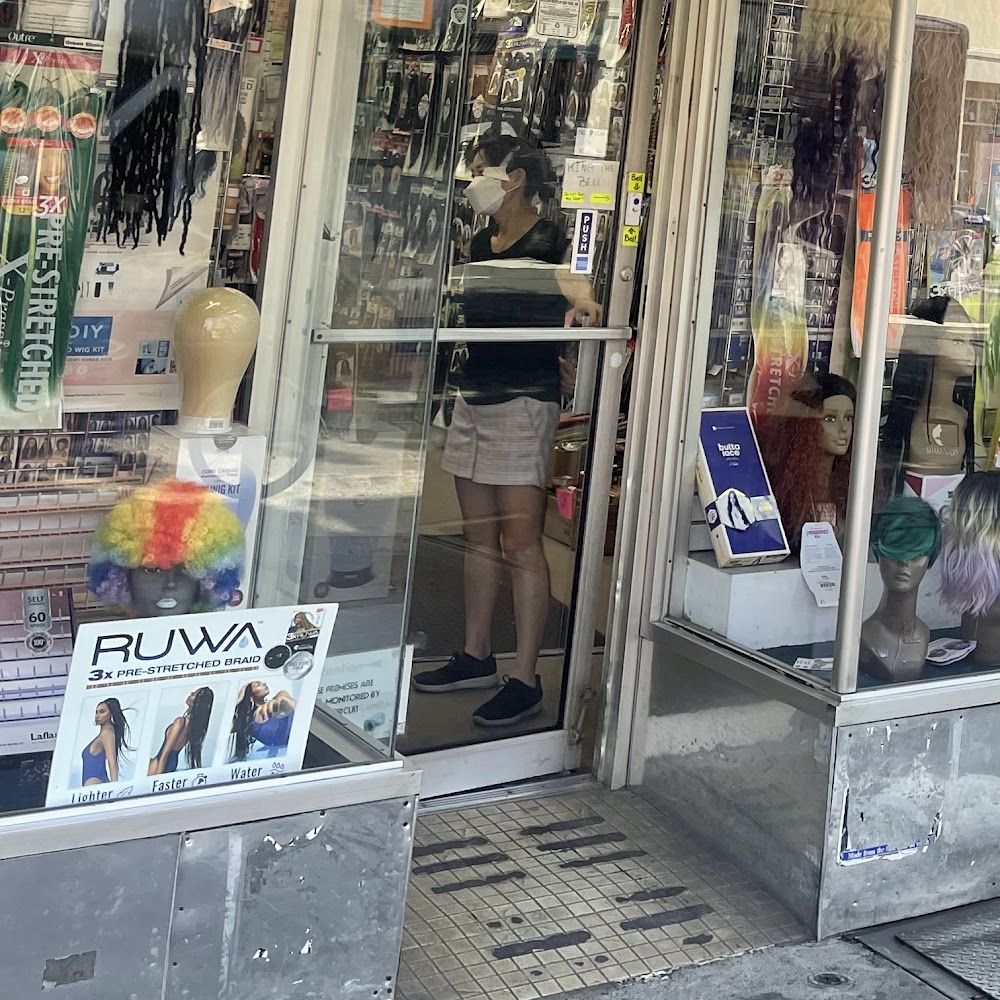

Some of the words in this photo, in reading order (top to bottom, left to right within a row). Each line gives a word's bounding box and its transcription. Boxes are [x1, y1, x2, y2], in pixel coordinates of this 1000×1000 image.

[34, 195, 66, 219] 3X
[580, 215, 591, 252] PUSH
[16, 215, 66, 413] PRE-STRETCHED
[74, 346, 90, 354] WIG
[92, 345, 106, 354] KIT
[717, 443, 741, 451] butta
[227, 484, 241, 495] KIT
[27, 595, 46, 603] SELF
[28, 611, 46, 623] 60
[91, 622, 262, 666] RUWA
[88, 669, 113, 682] 3x
[116, 658, 222, 679] PRE-STRETCHED
[224, 655, 262, 666] BRAID
[360, 679, 375, 689] ARE
[325, 692, 370, 705] MONITORED
[370, 690, 381, 699] BY
[230, 766, 263, 780] Water
[152, 776, 189, 792] Faster
